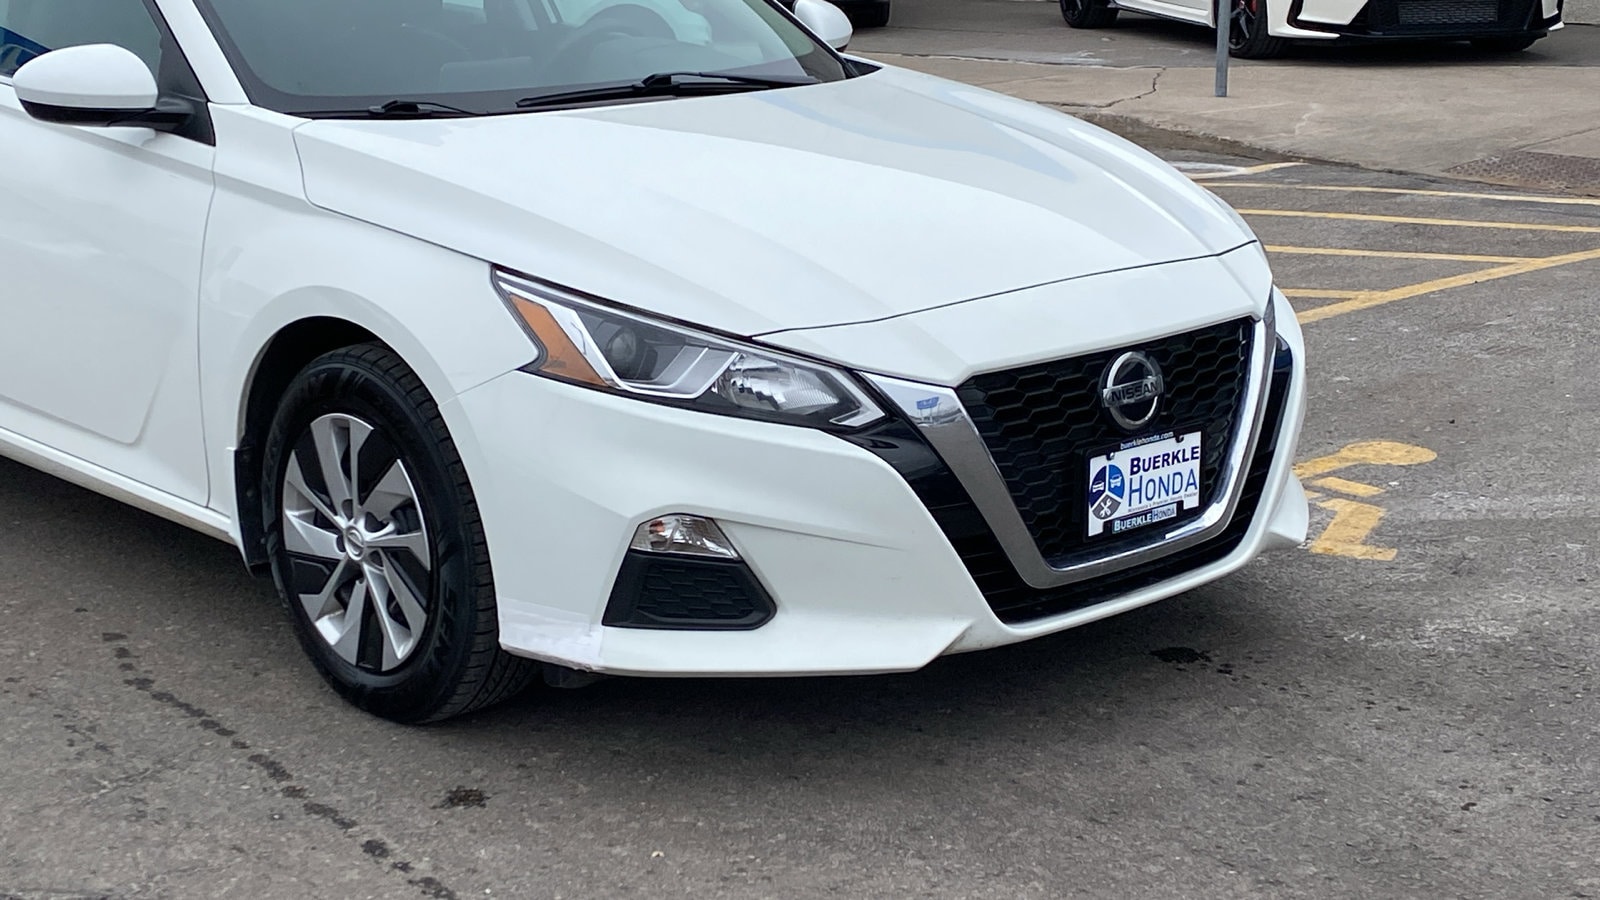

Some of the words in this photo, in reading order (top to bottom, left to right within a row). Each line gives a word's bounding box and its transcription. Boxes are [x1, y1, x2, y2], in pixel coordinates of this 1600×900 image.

[1111, 382, 1157, 401] NISSAN
[1129, 446, 1200, 476] BUERKLE
[1128, 468, 1198, 507] HONDA
[1114, 513, 1152, 531] BUERKLE
[1152, 508, 1175, 521] HONDA
